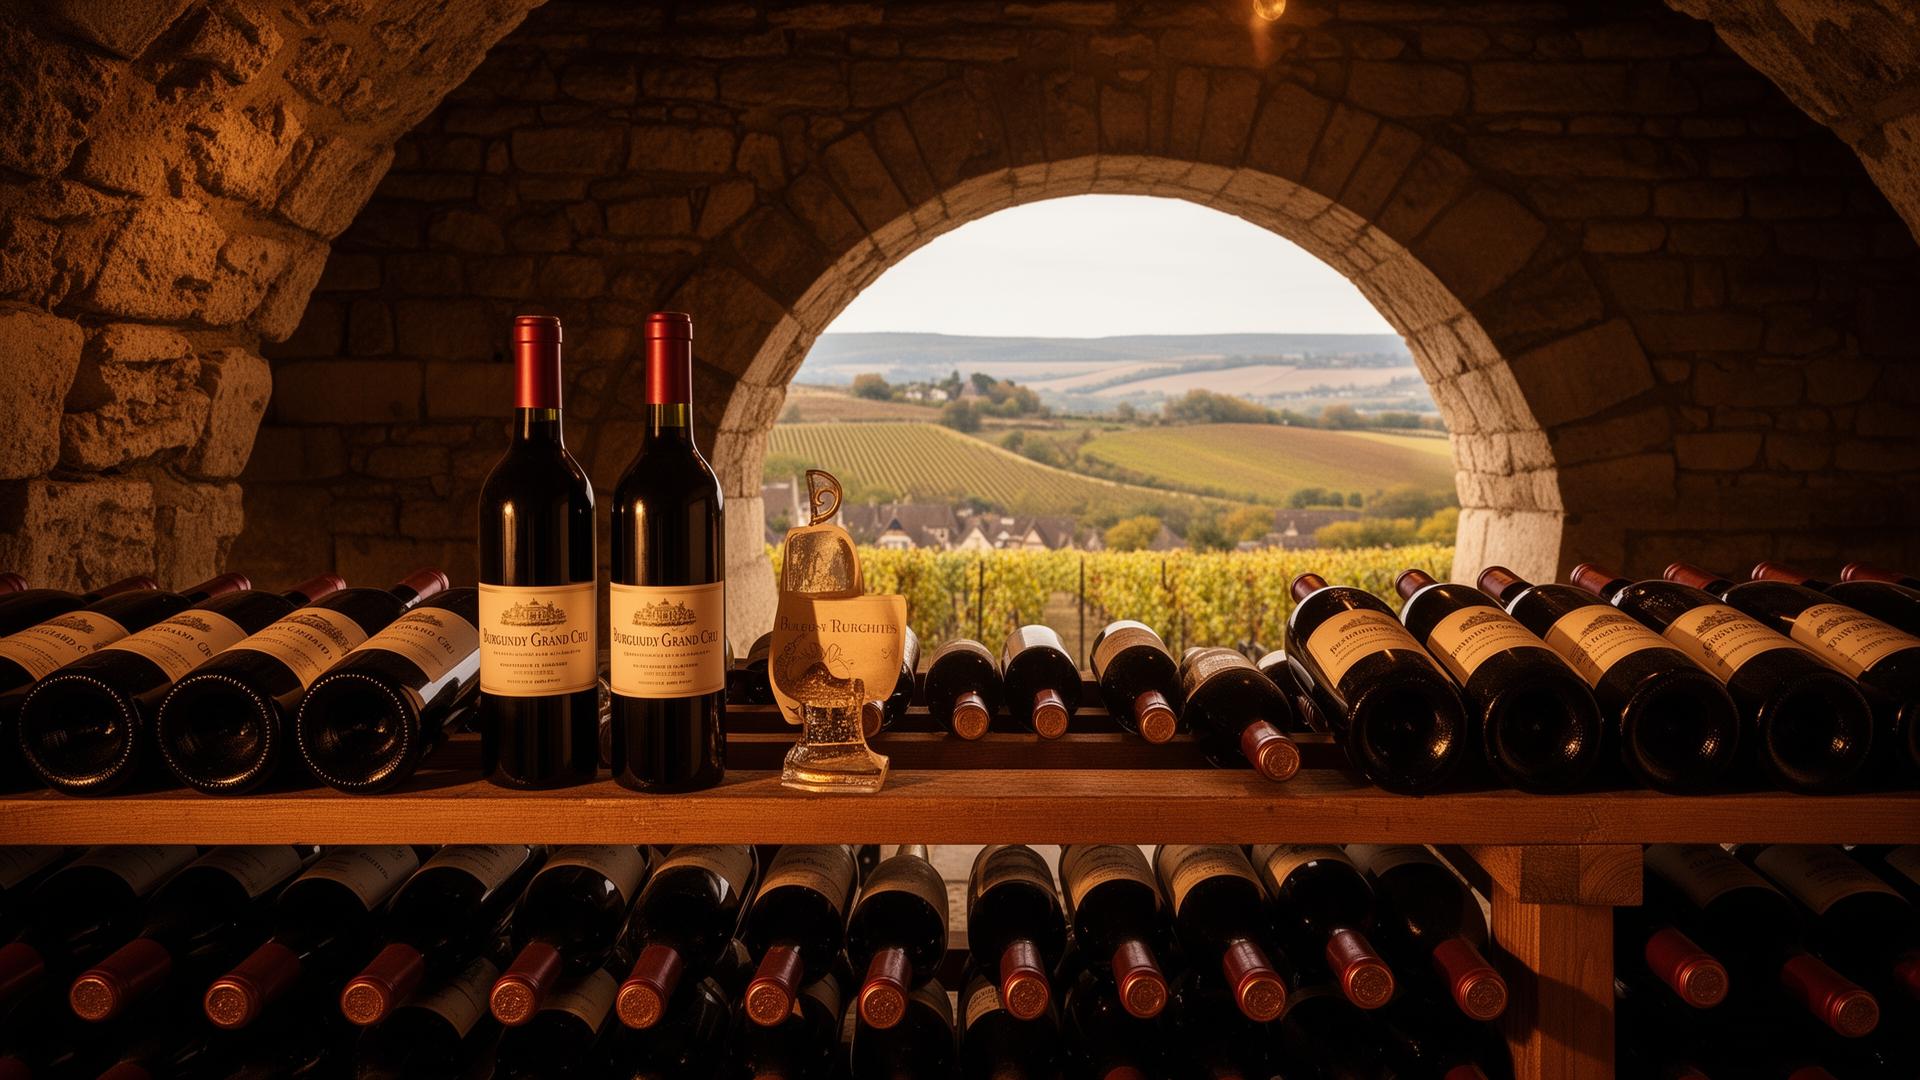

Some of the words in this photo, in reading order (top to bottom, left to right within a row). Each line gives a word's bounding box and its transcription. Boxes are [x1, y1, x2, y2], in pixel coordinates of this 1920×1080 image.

[483, 627, 528, 647] BURGUNDY
[530, 631, 569, 647] GRAND
[570, 629, 589, 644] CRU
[661, 632, 699, 648] GRAND
[700, 629, 718, 644] CRU
